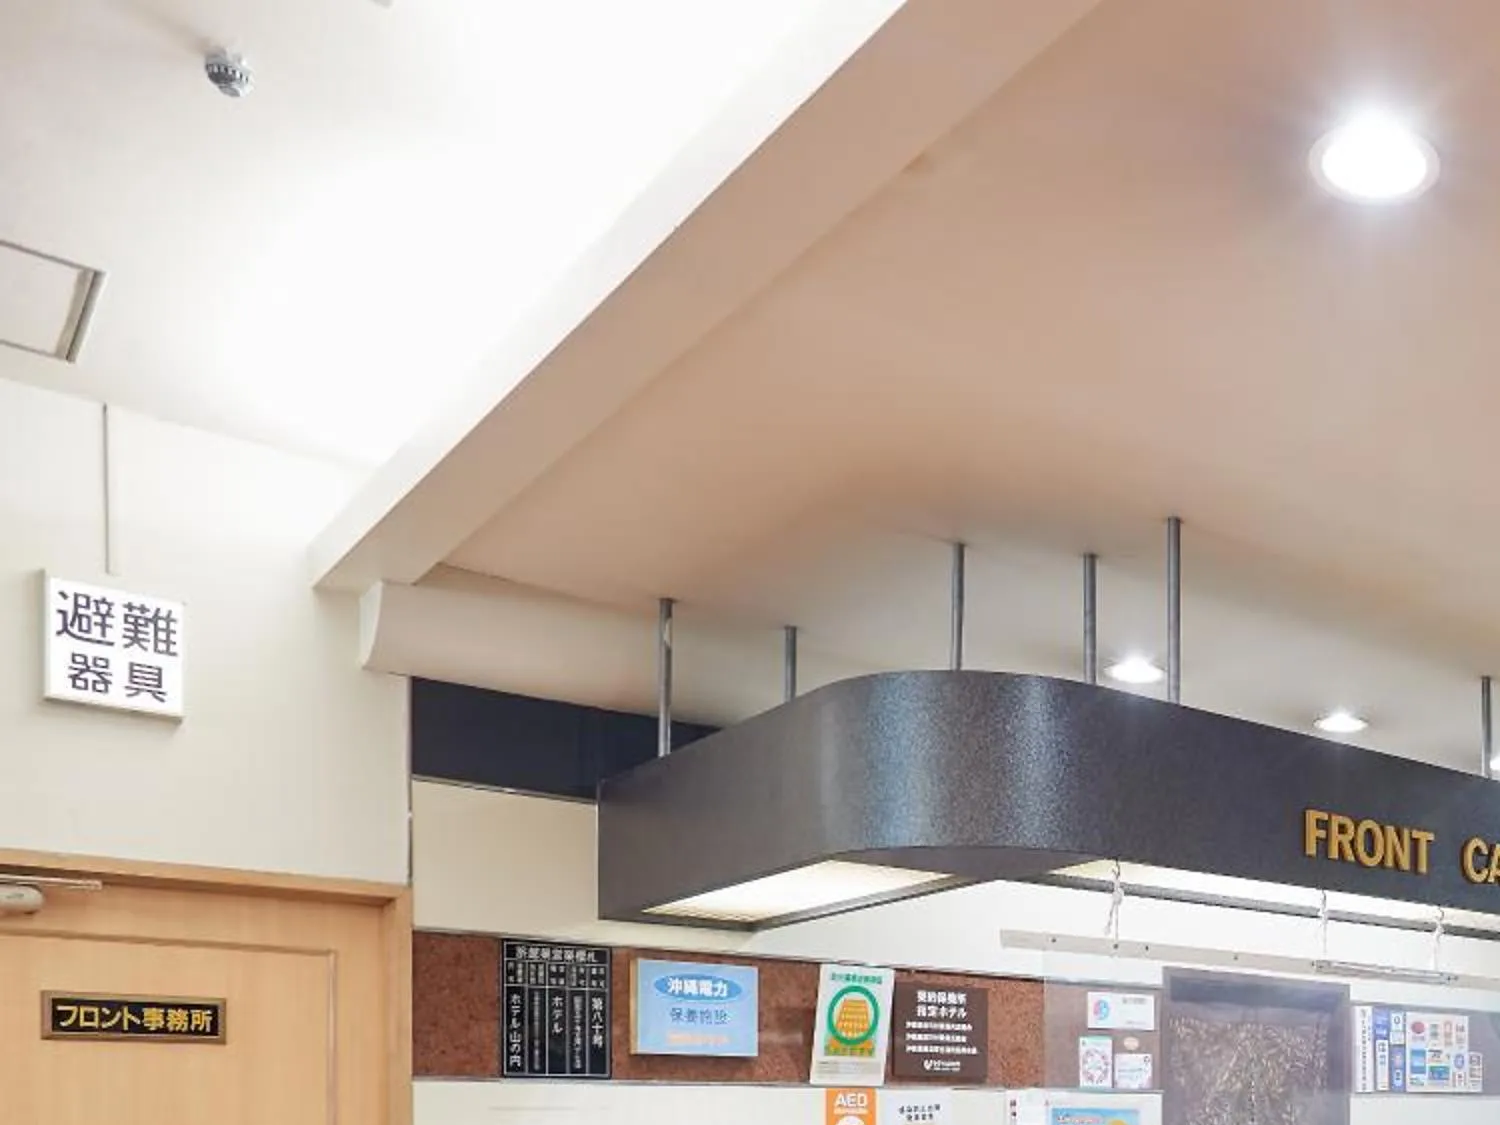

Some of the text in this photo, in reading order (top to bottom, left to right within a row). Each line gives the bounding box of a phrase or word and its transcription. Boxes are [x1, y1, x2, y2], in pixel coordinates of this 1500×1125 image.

[56, 590, 178, 657] 避難
[68, 652, 167, 703] 器具
[1303, 807, 1435, 875] FRONT
[668, 977, 728, 997] 沖縄電力
[56, 1005, 213, 1033] フロント事務所
[552, 995, 563, 1034] ホテル
[835, 1093, 868, 1107] AED
